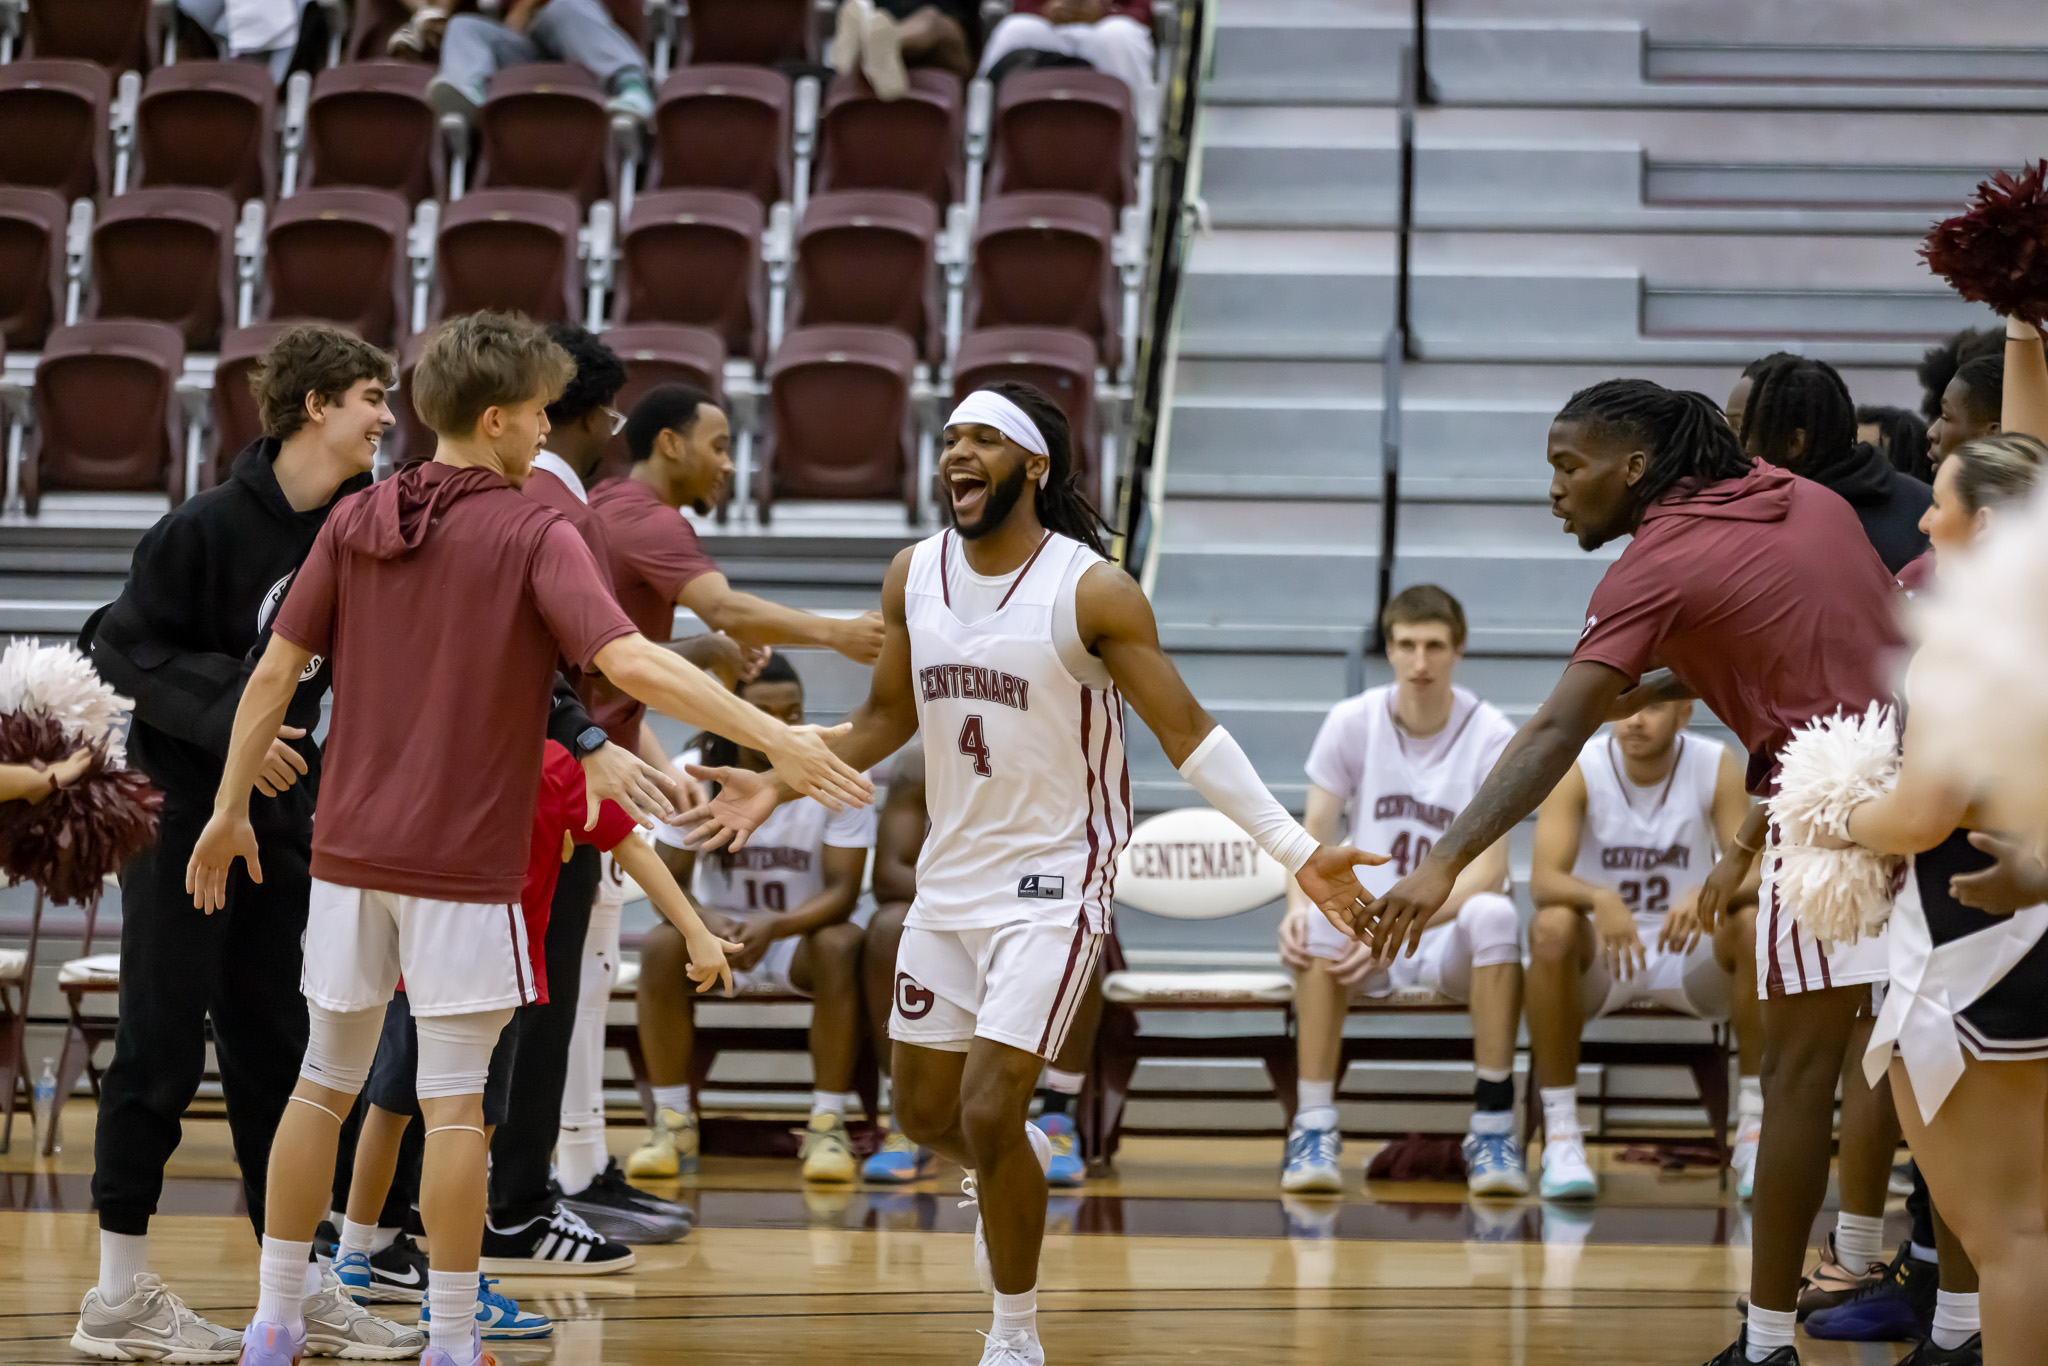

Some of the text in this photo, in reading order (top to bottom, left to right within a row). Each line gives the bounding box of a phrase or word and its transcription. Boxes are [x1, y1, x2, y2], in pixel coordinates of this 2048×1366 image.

[919, 664, 1029, 711] CENTENARY
[958, 714, 992, 777] 4
[1130, 841, 1259, 880] CENTENARY
[744, 879, 787, 912] 10
[1619, 876, 1669, 912] 22
[898, 976, 927, 1014] C
